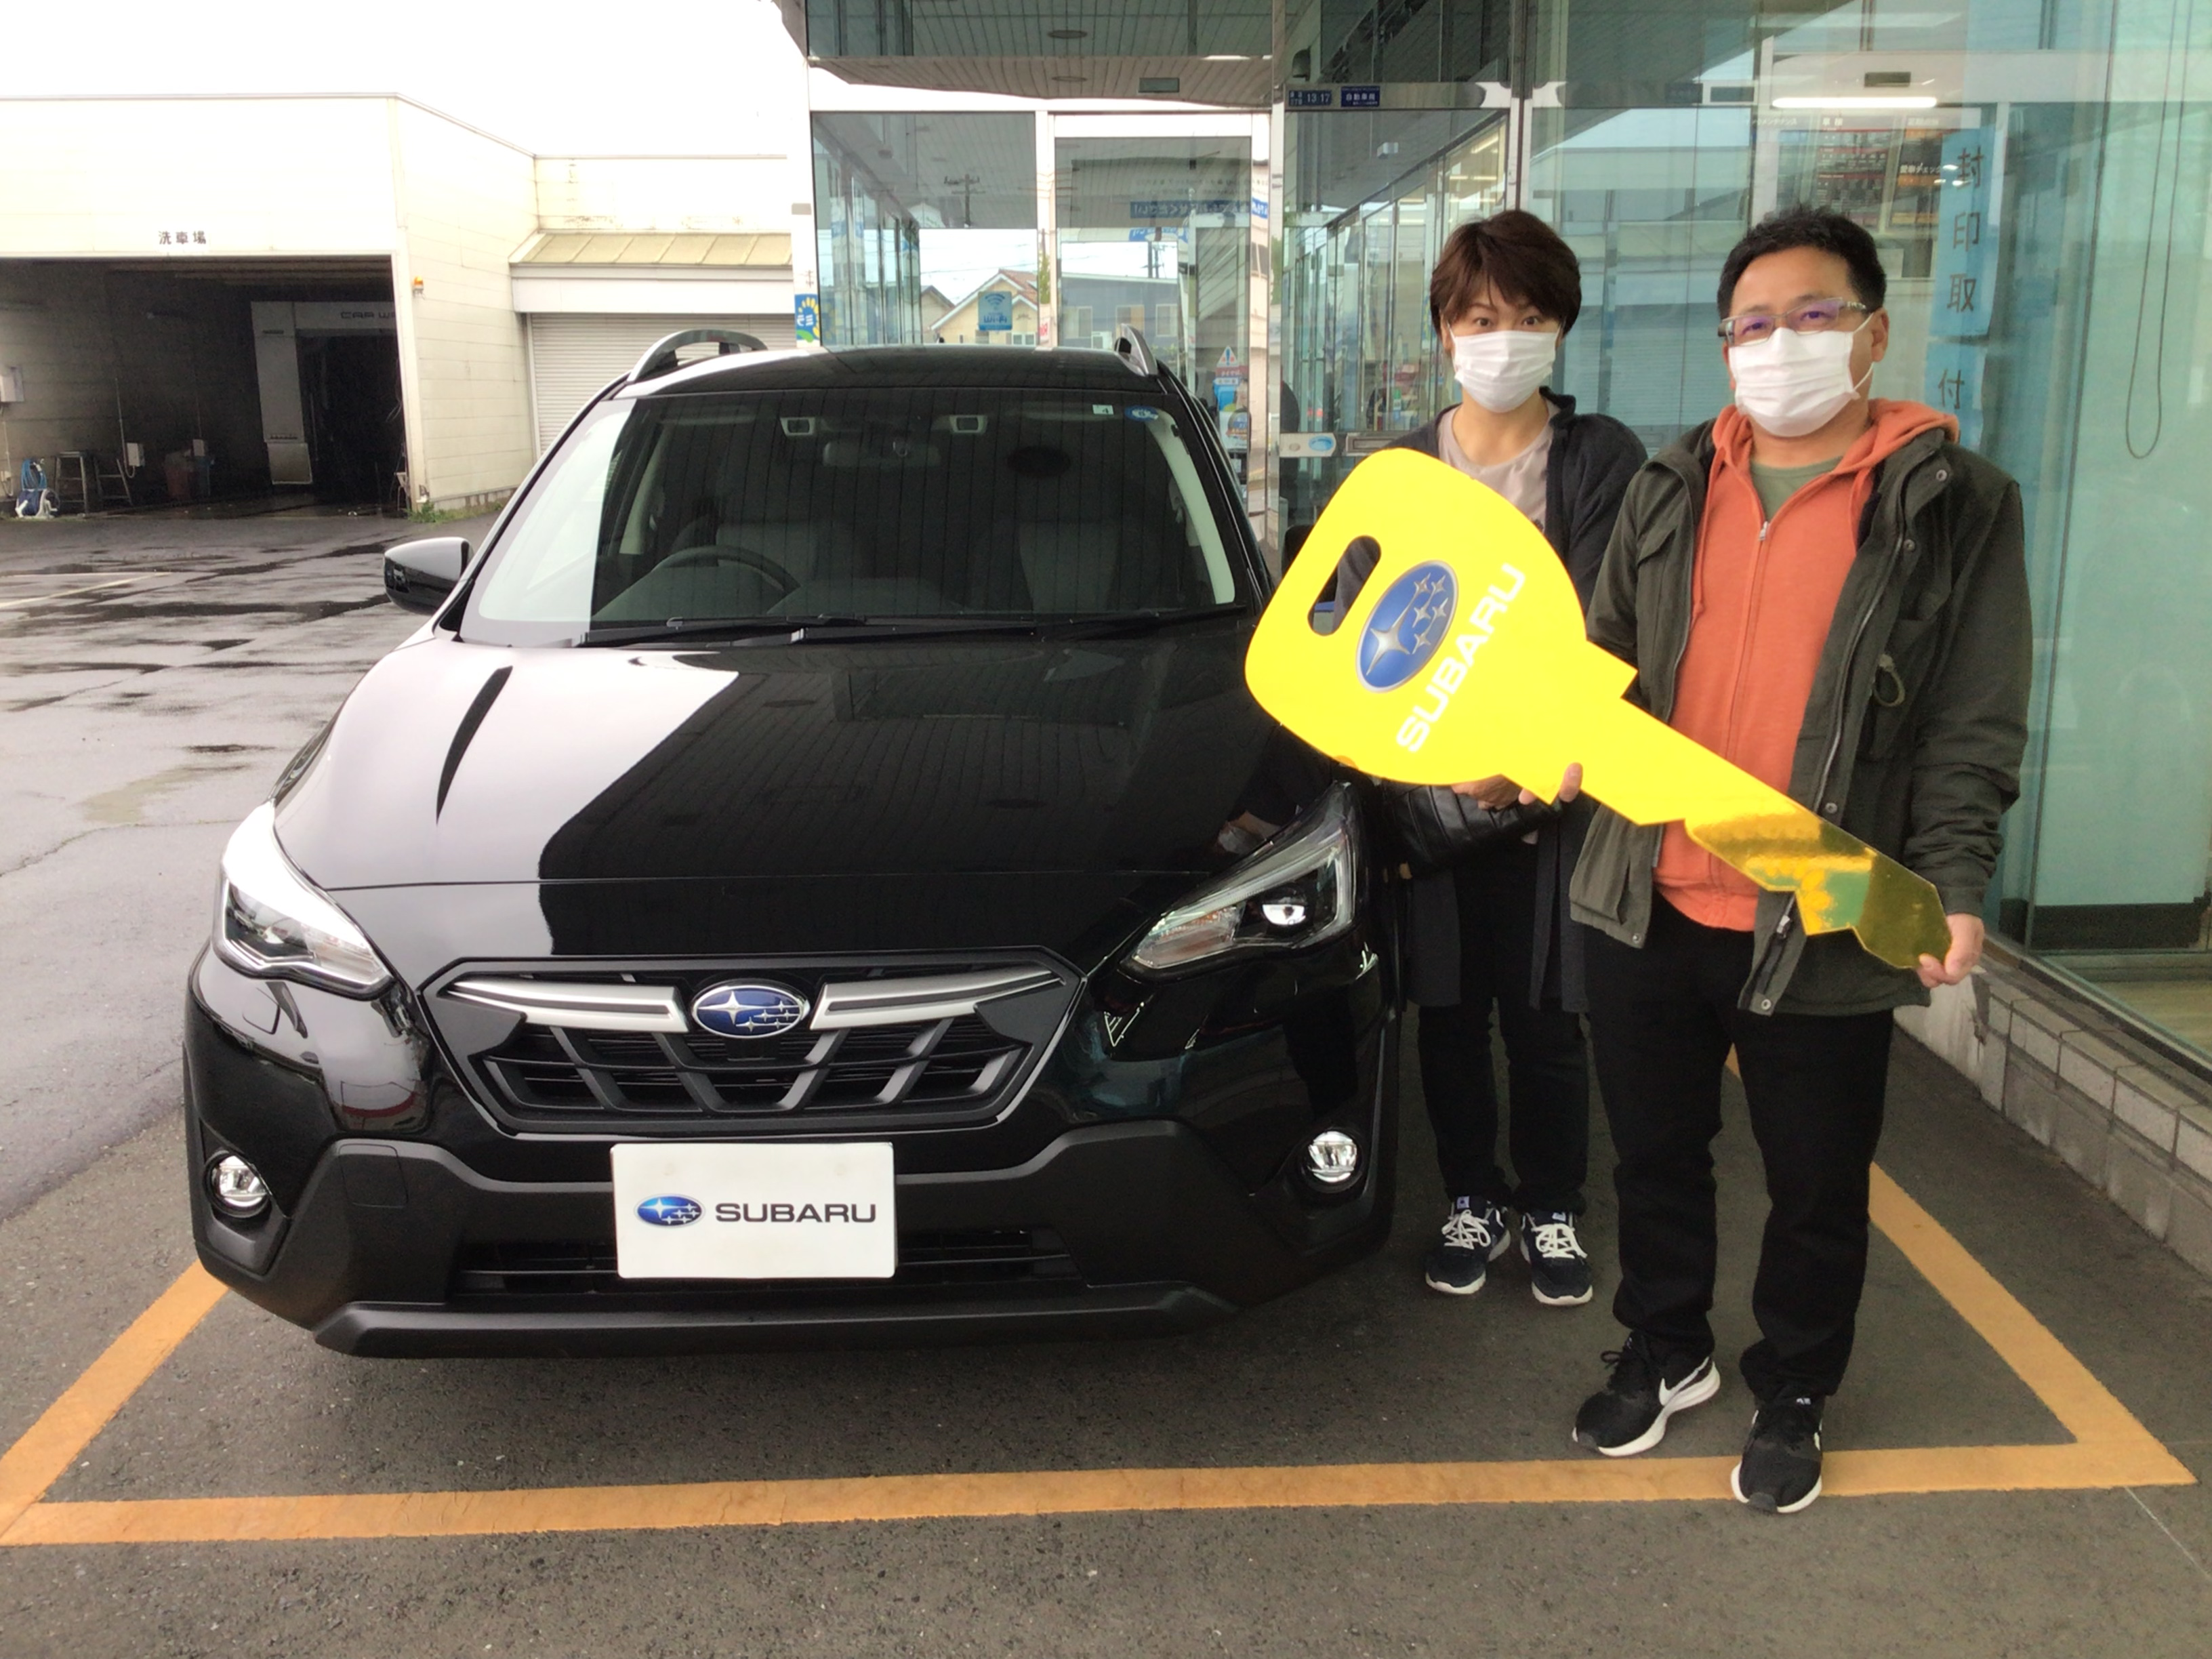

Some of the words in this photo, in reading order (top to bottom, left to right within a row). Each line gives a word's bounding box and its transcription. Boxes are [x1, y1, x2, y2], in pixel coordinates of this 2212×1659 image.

[159, 230, 206, 245] 洗車場
[1938, 144, 1985, 444] 封印取付
[341, 311, 375, 319] CAR
[1395, 562, 1525, 753] SUBARU
[715, 1203, 877, 1223] SUBARU
